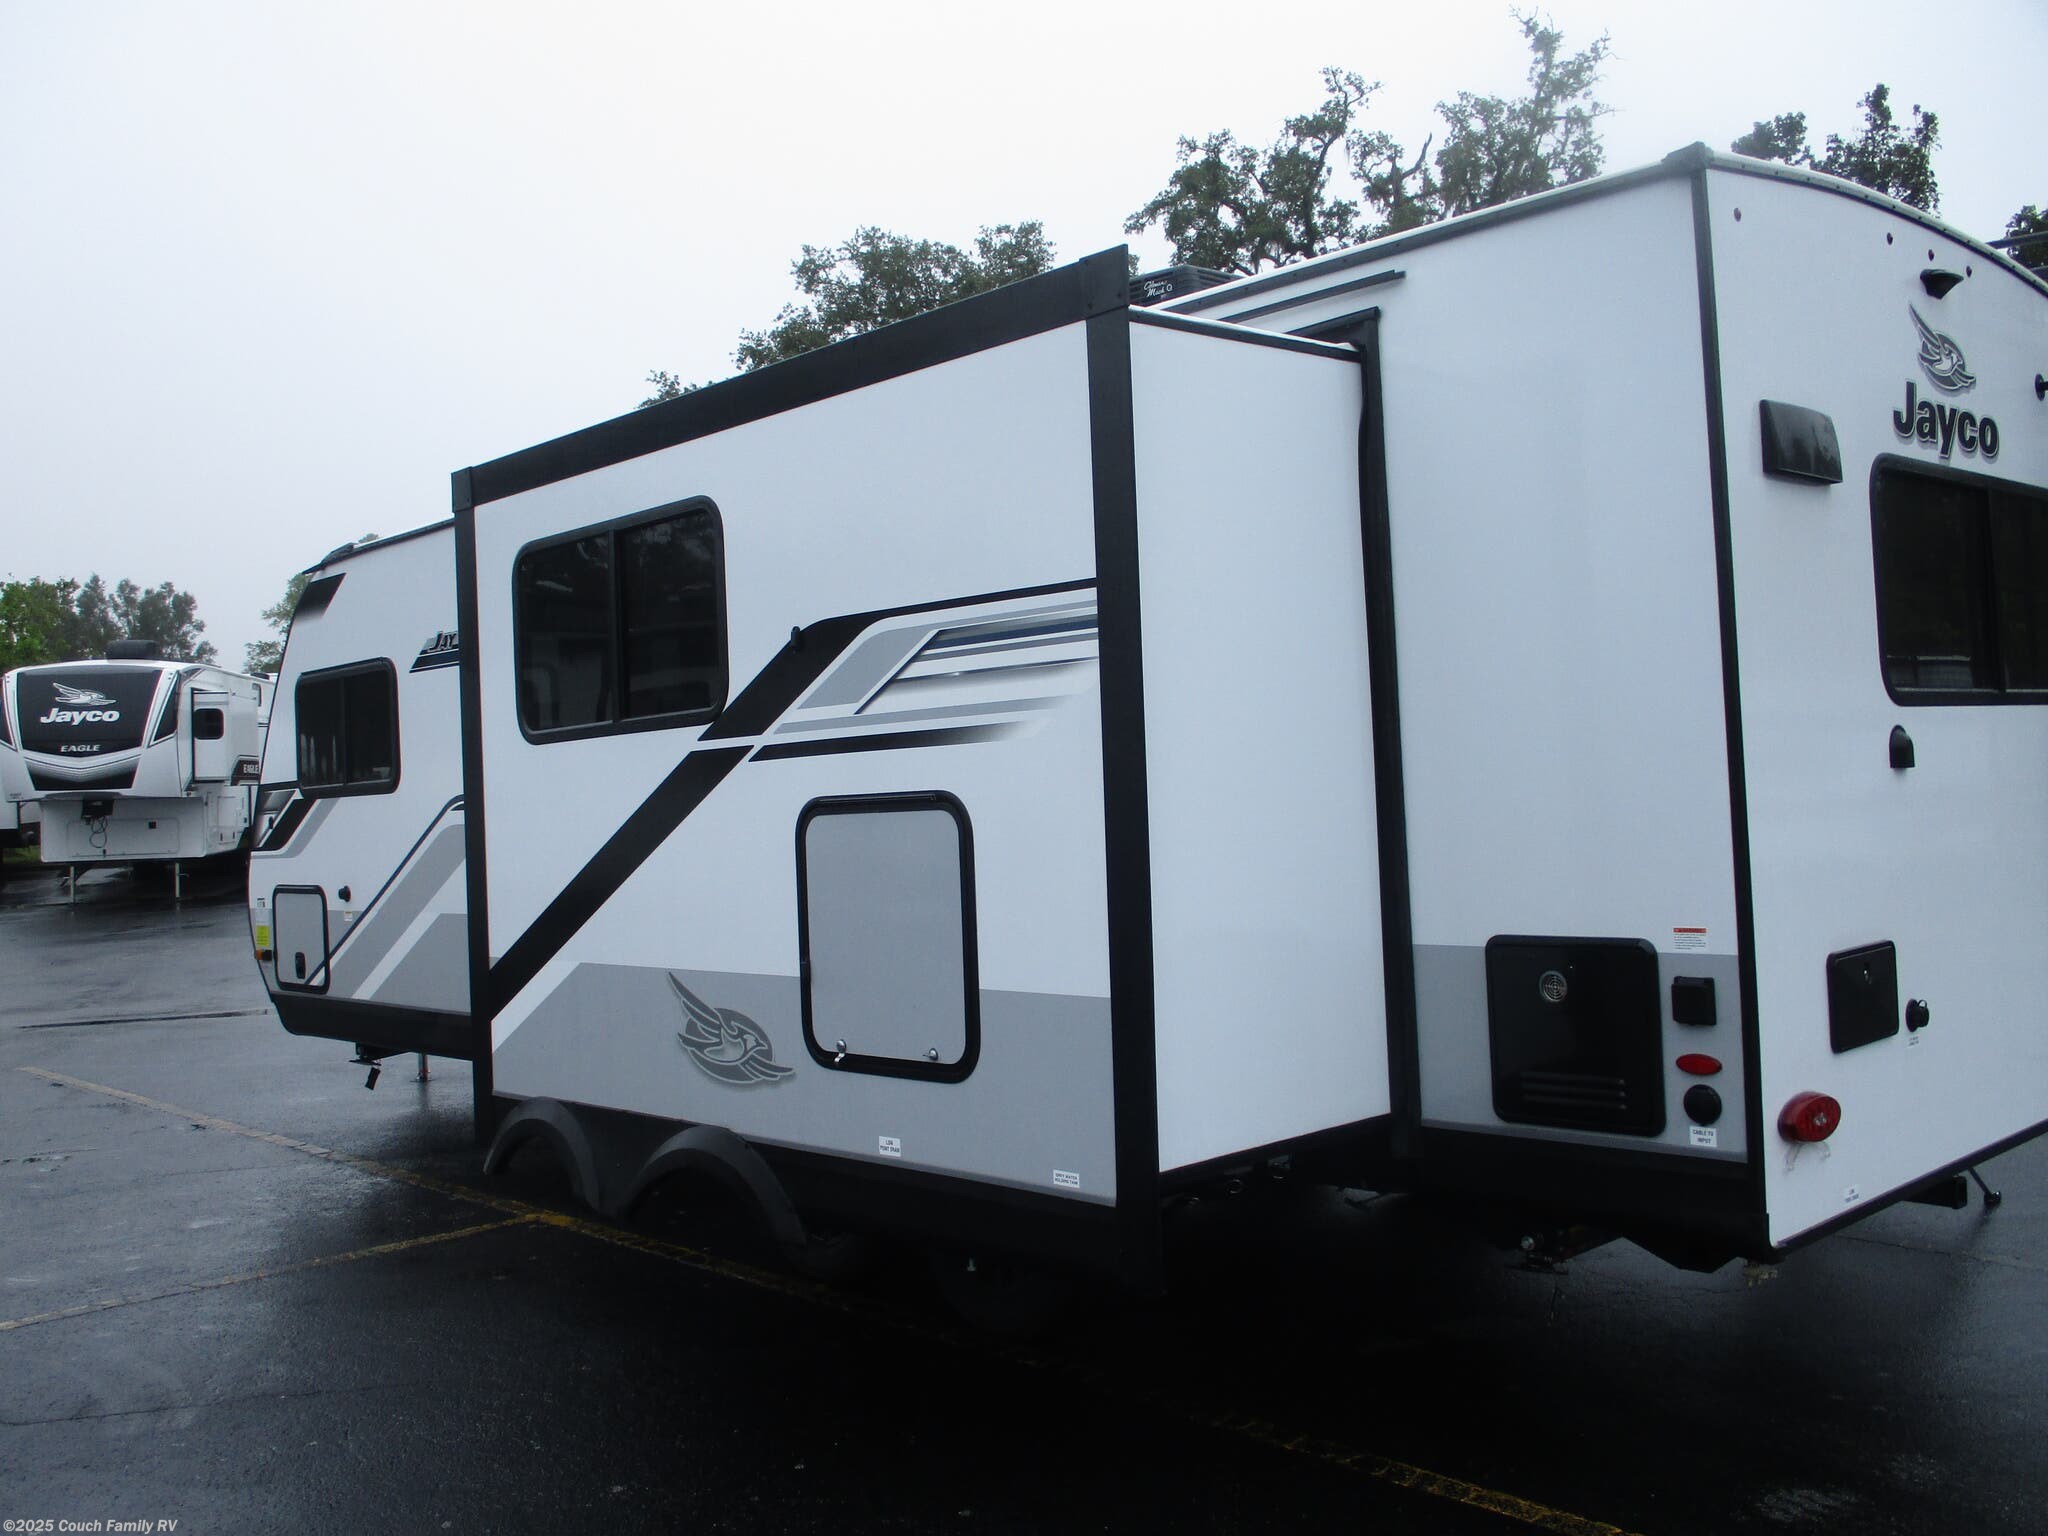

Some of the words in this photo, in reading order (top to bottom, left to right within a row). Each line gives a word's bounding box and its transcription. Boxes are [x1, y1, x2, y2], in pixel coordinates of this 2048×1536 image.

[1893, 380, 1999, 458] Jayco
[40, 707, 120, 726] Jayco
[61, 744, 101, 752] EAGLE
